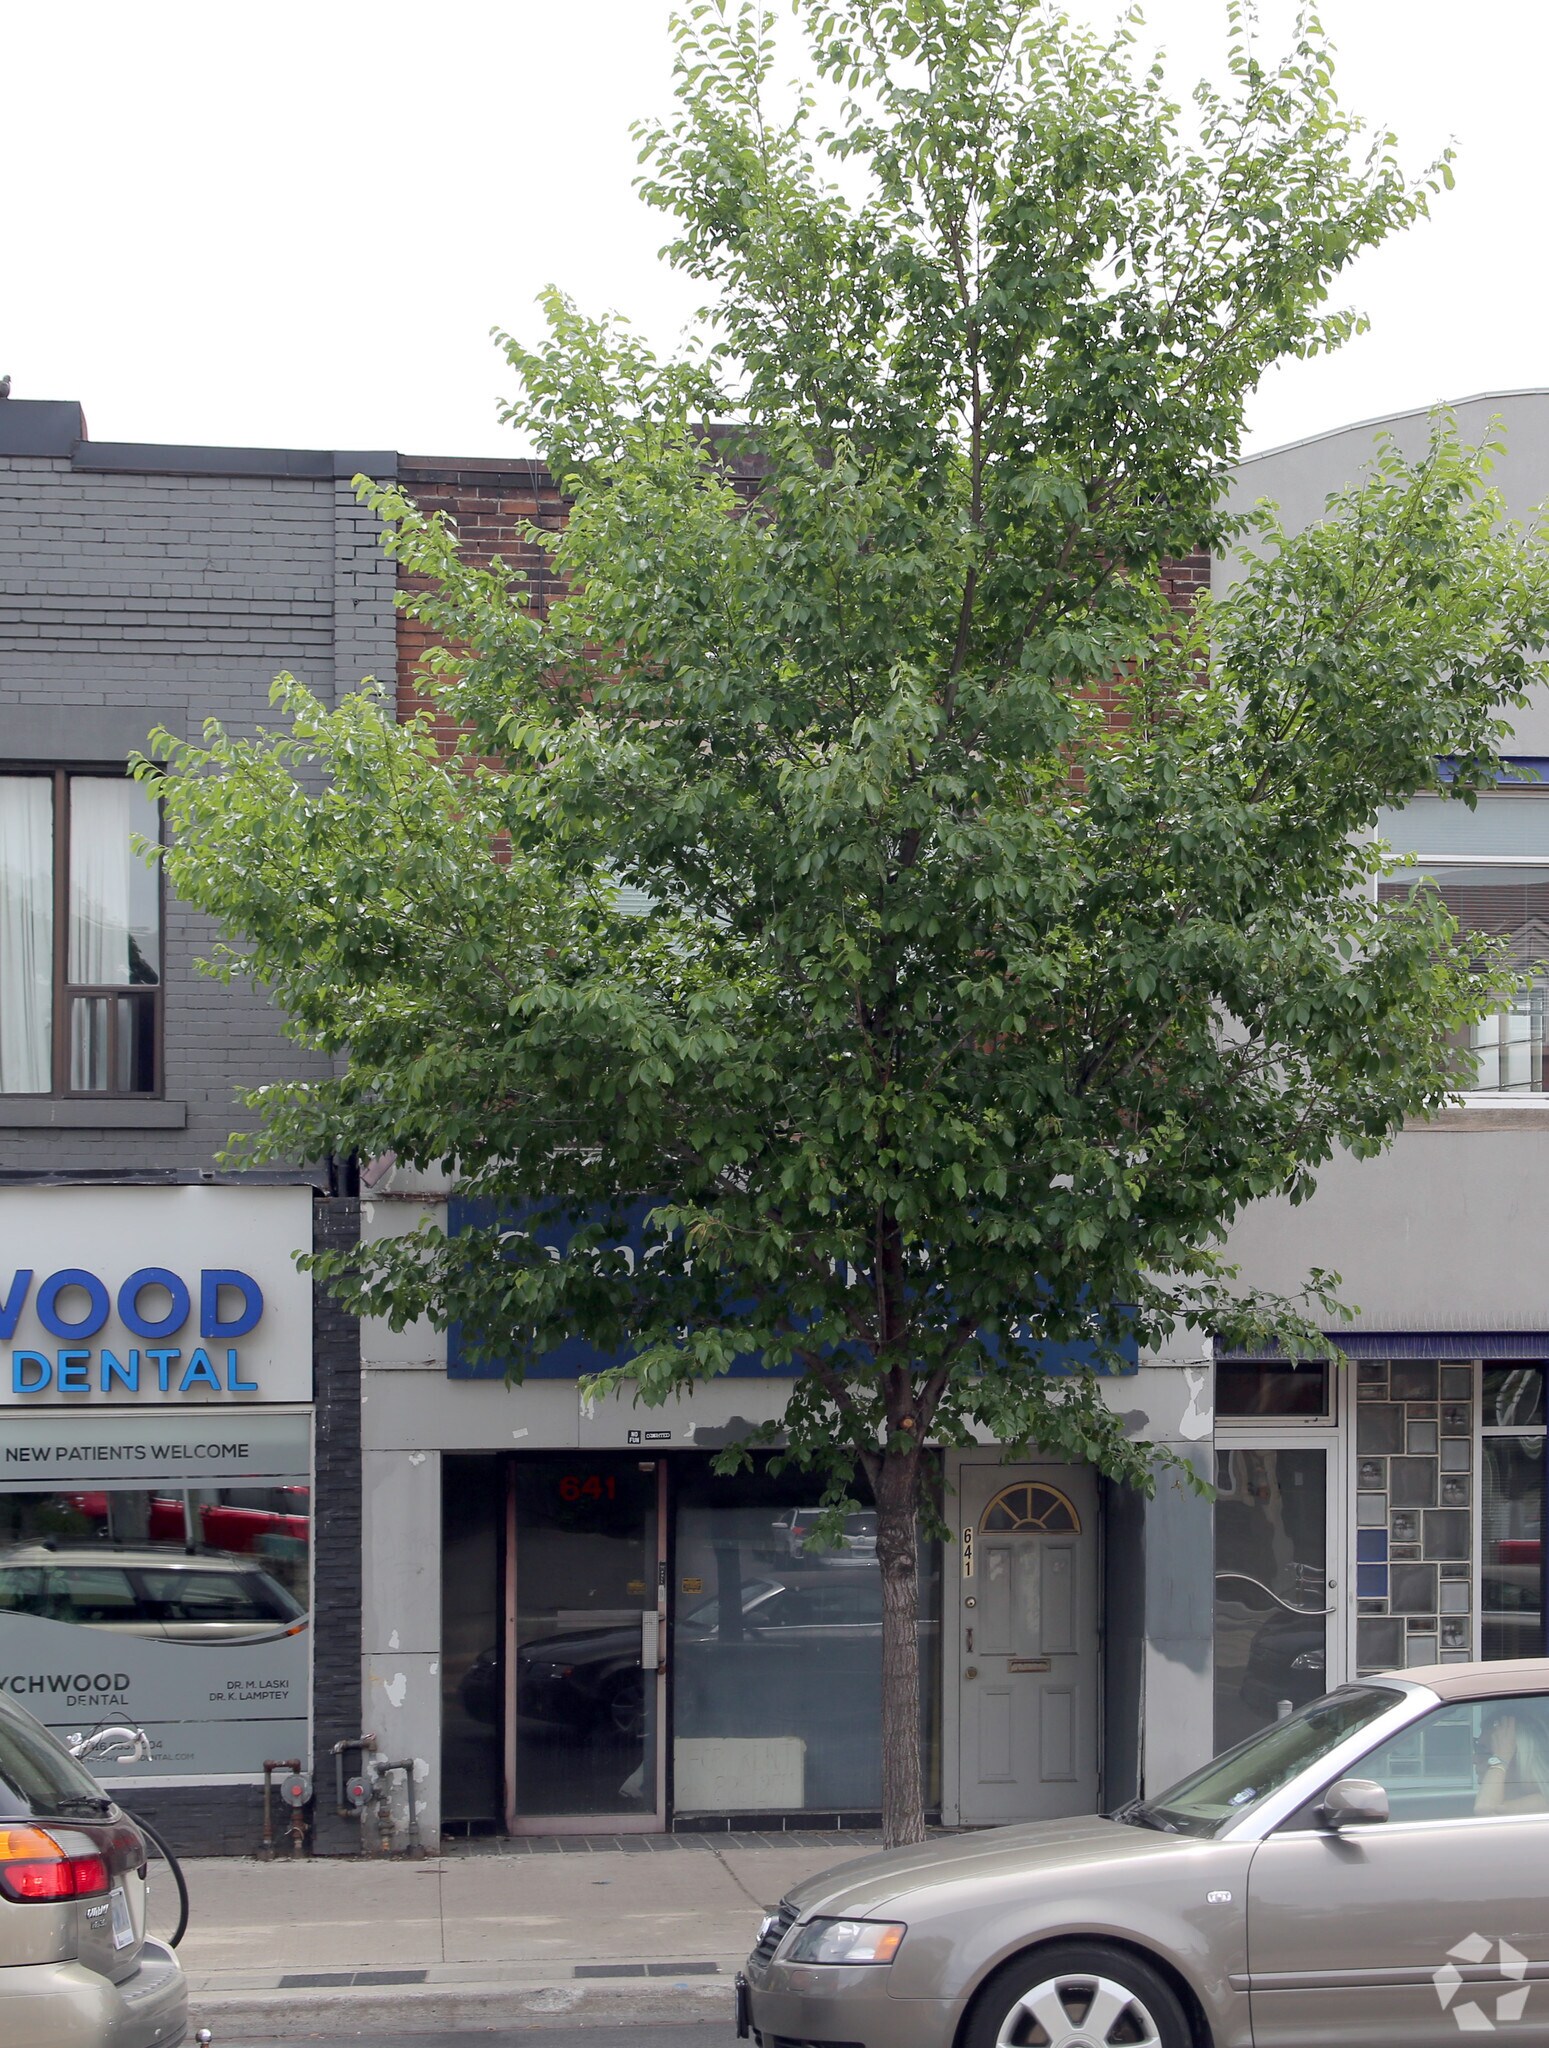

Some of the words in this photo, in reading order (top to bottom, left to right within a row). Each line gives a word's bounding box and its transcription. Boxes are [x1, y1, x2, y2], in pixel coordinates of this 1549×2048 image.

[12, 1347, 258, 1393] DENTAL
[6, 1447, 51, 1462] NEW
[55, 1445, 146, 1461] PATIENTS
[150, 1444, 249, 1459] WELCOME
[559, 1475, 616, 1501] 641
[964, 1528, 972, 1576] 641
[226, 1681, 243, 1690] DR.
[246, 1681, 257, 1689] M.
[259, 1680, 289, 1689] LASKI
[66, 1694, 129, 1707] DENTAL
[209, 1692, 226, 1701] DR.
[228, 1692, 237, 1701] K.
[239, 1691, 289, 1701] LAMPTEY
